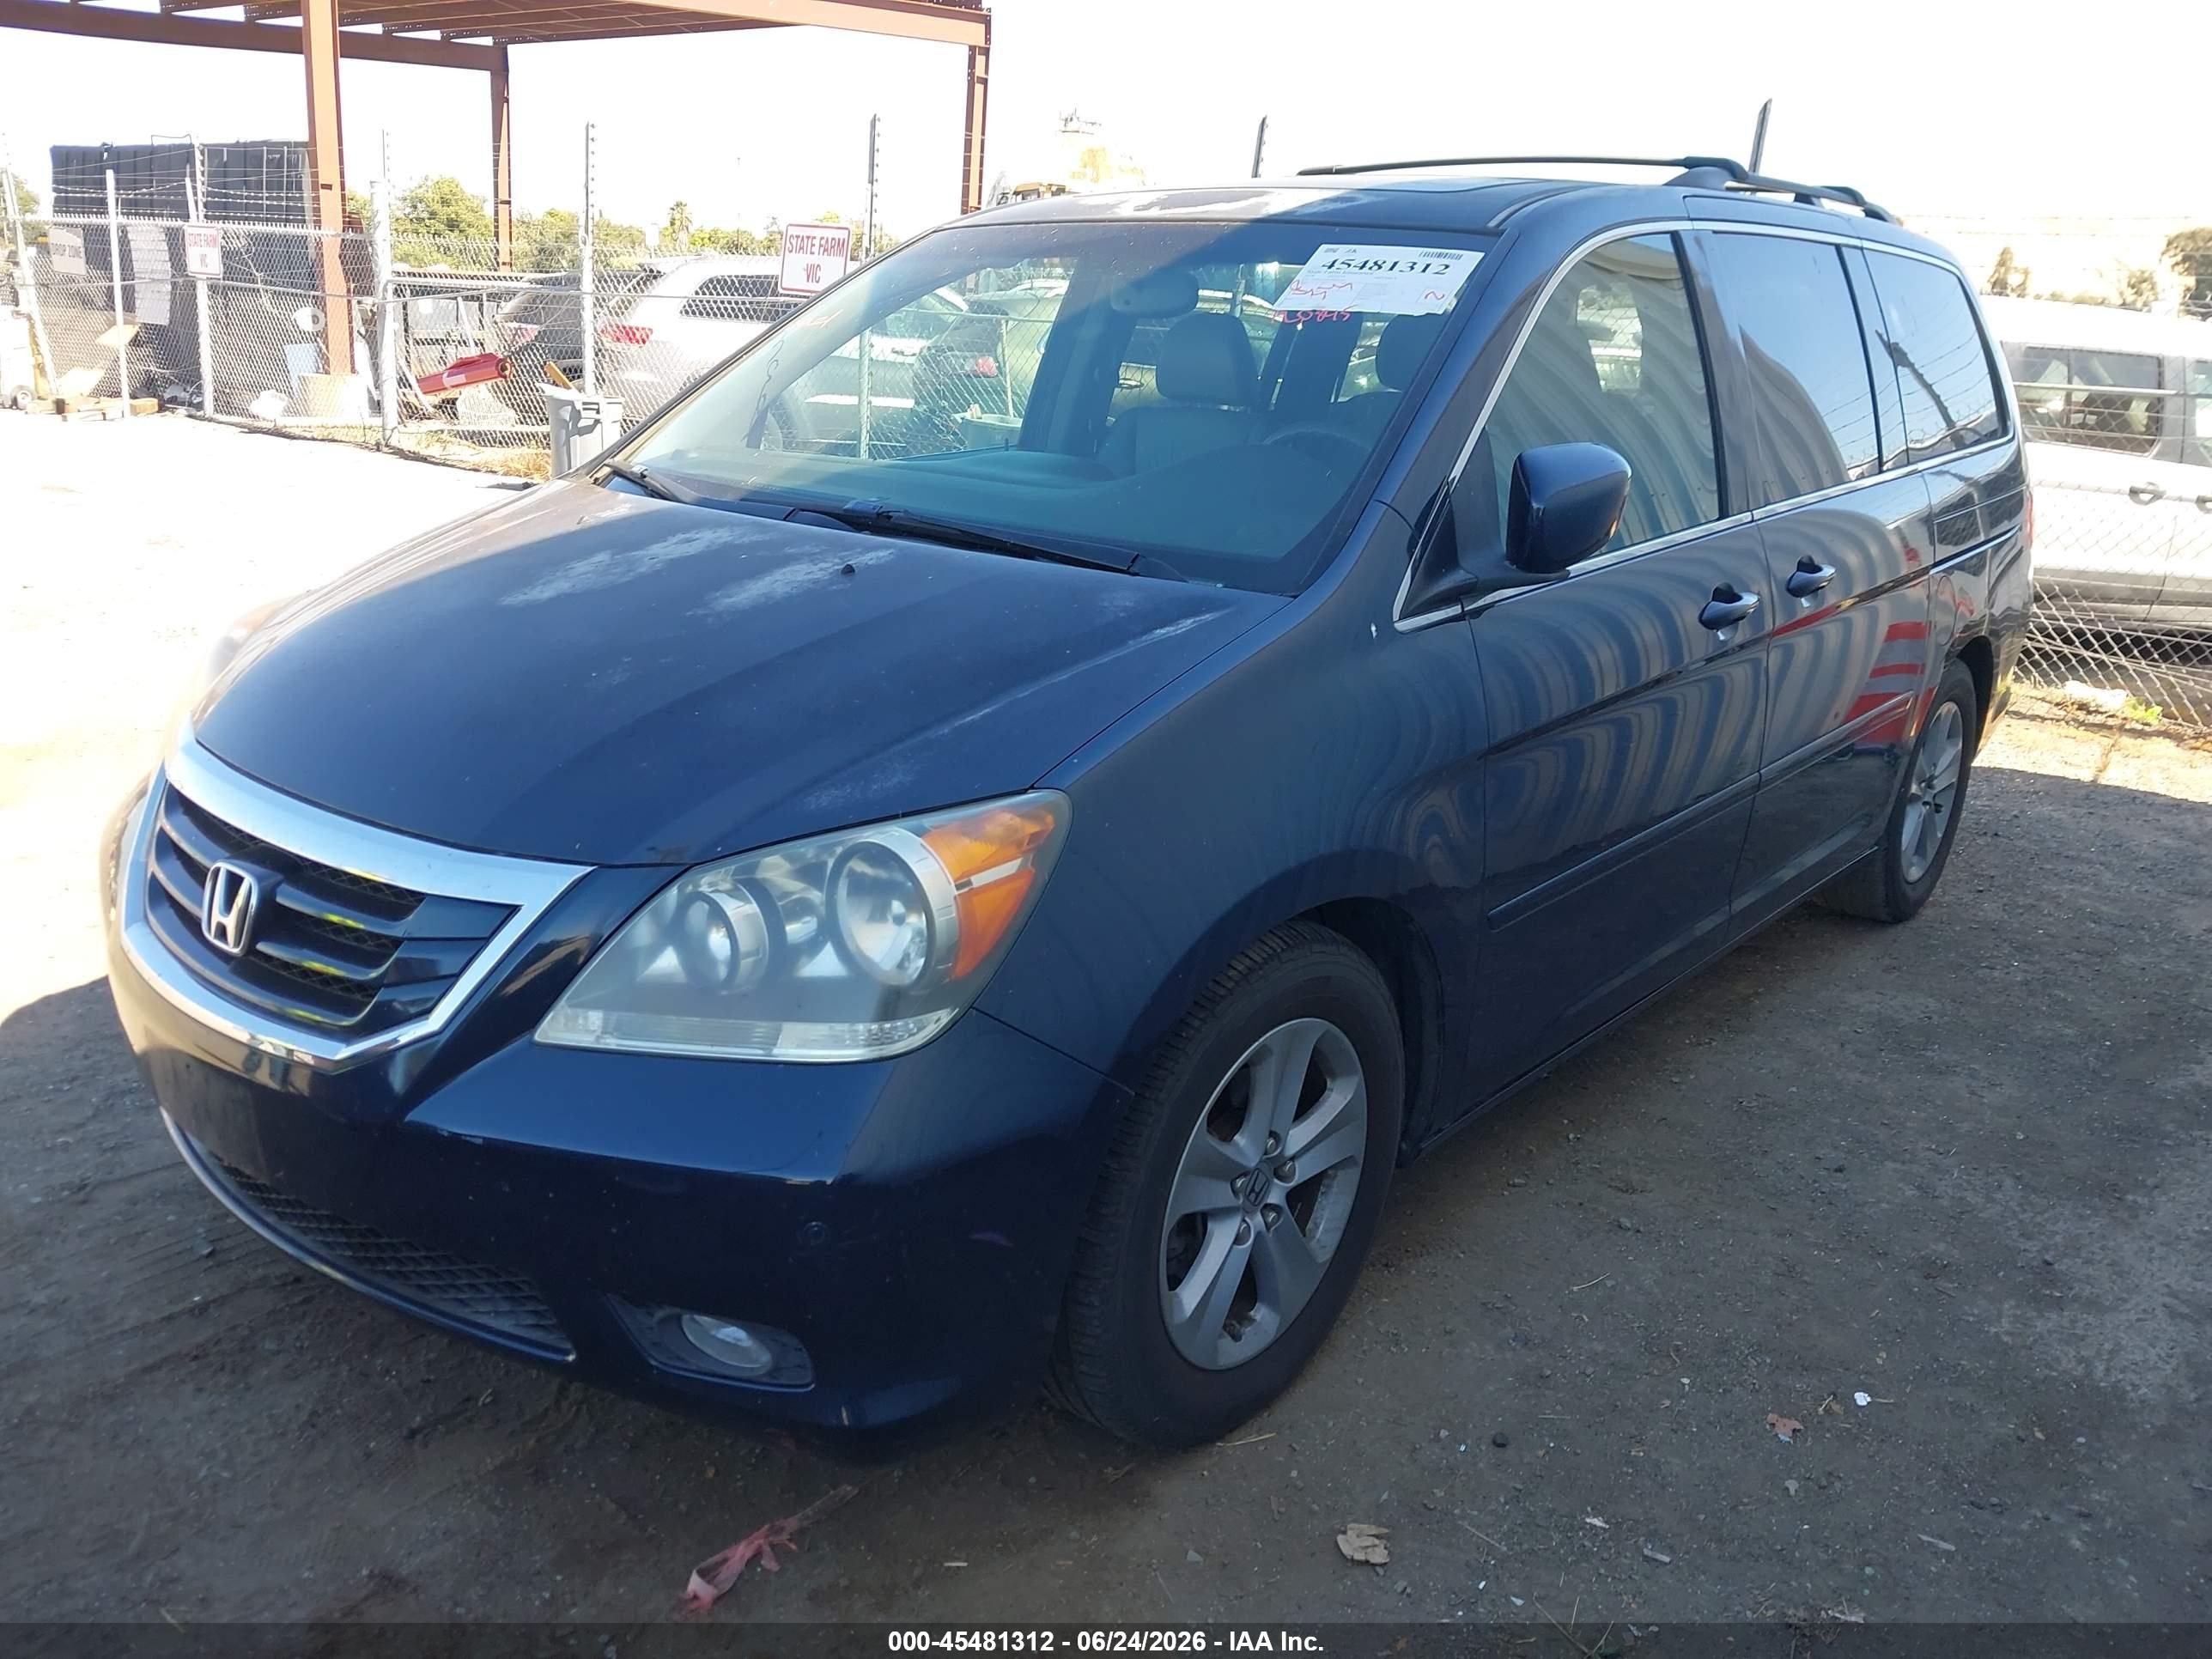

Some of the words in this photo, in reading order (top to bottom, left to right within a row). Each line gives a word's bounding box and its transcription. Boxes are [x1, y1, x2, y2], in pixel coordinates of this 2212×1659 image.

[787, 234, 817, 255] STATE
[817, 236, 846, 258] FARM
[805, 263, 822, 283] VIC
[1322, 258, 1450, 275] 45481312
